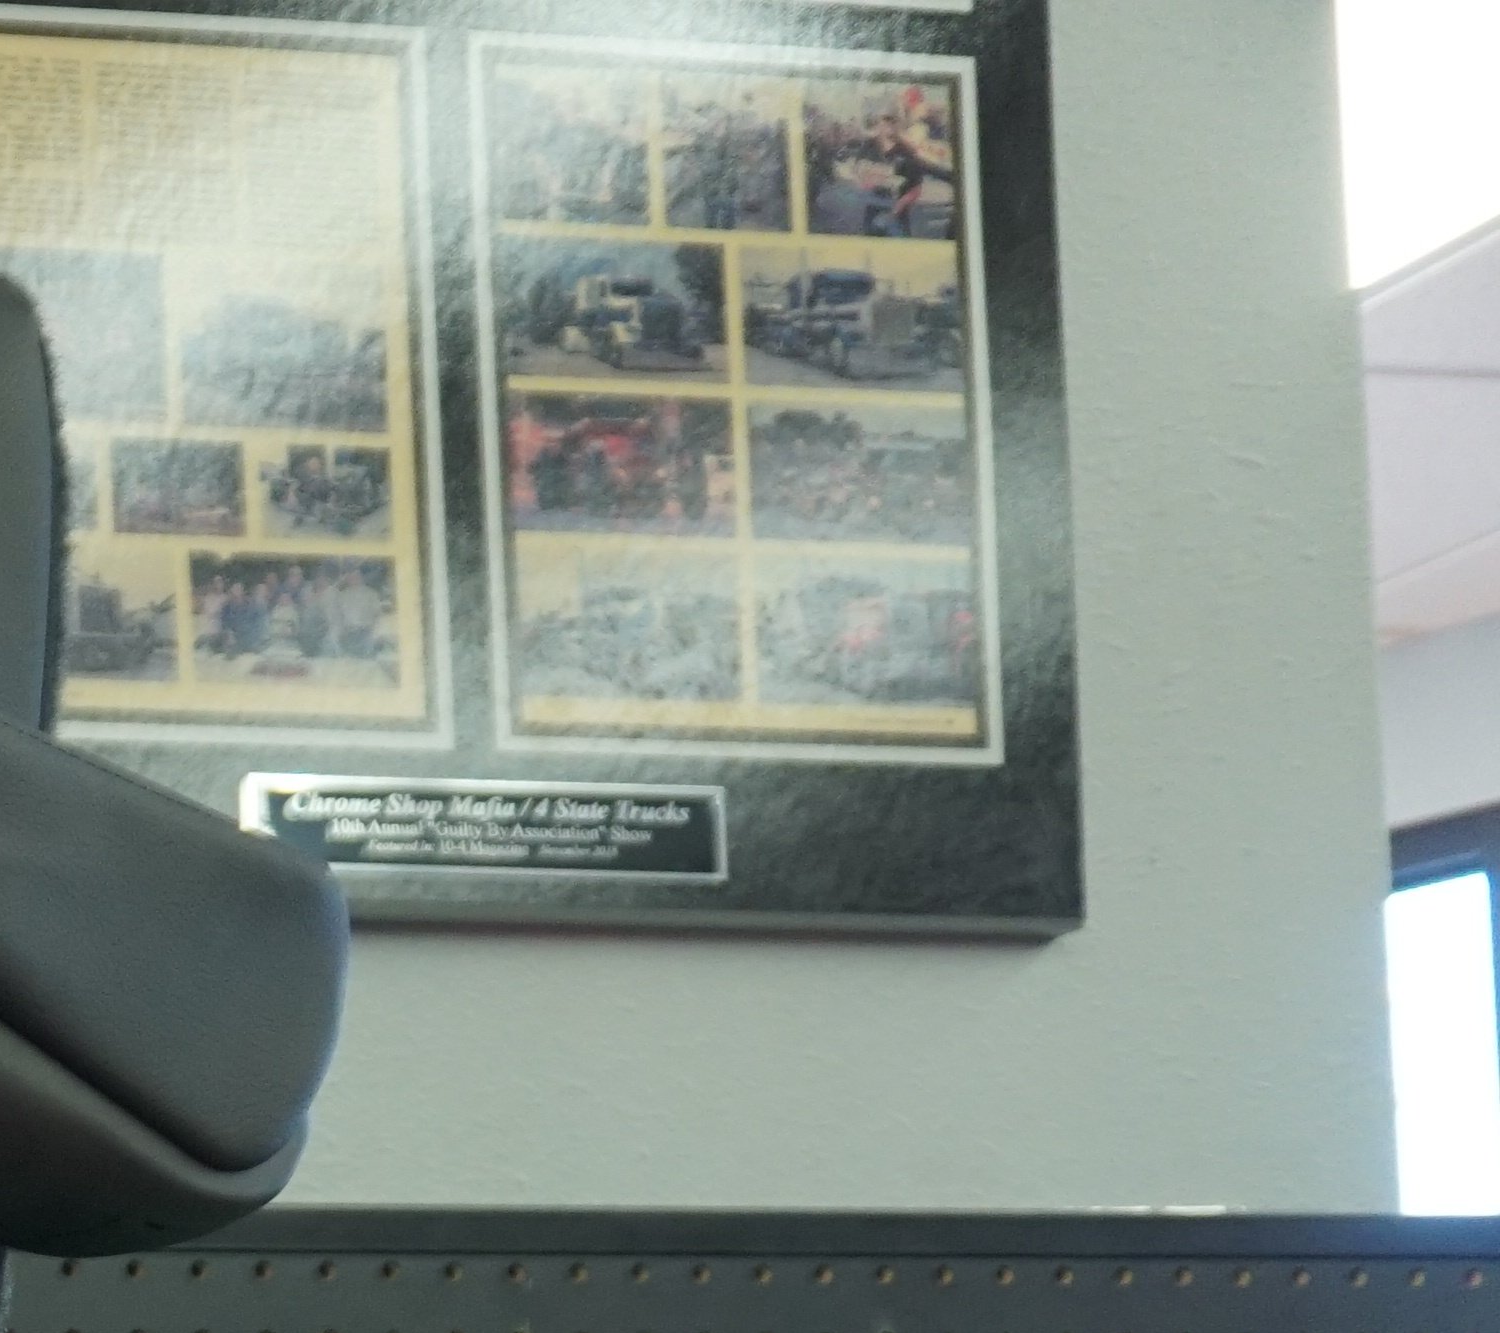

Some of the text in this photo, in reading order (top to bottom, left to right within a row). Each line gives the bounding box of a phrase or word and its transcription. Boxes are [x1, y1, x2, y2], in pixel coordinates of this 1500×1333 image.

[290, 791, 380, 813] Chrome
[386, 793, 443, 819] Shop
[449, 796, 515, 821] Mafia
[533, 798, 548, 817] 4
[554, 798, 610, 820] State
[616, 799, 691, 822] Trucks
[331, 817, 366, 835] 10th
[369, 819, 423, 835] Annual
[487, 824, 511, 841] By
[611, 826, 653, 842] Show
[367, 839, 418, 852] Featured
[472, 841, 530, 857] Magazine
